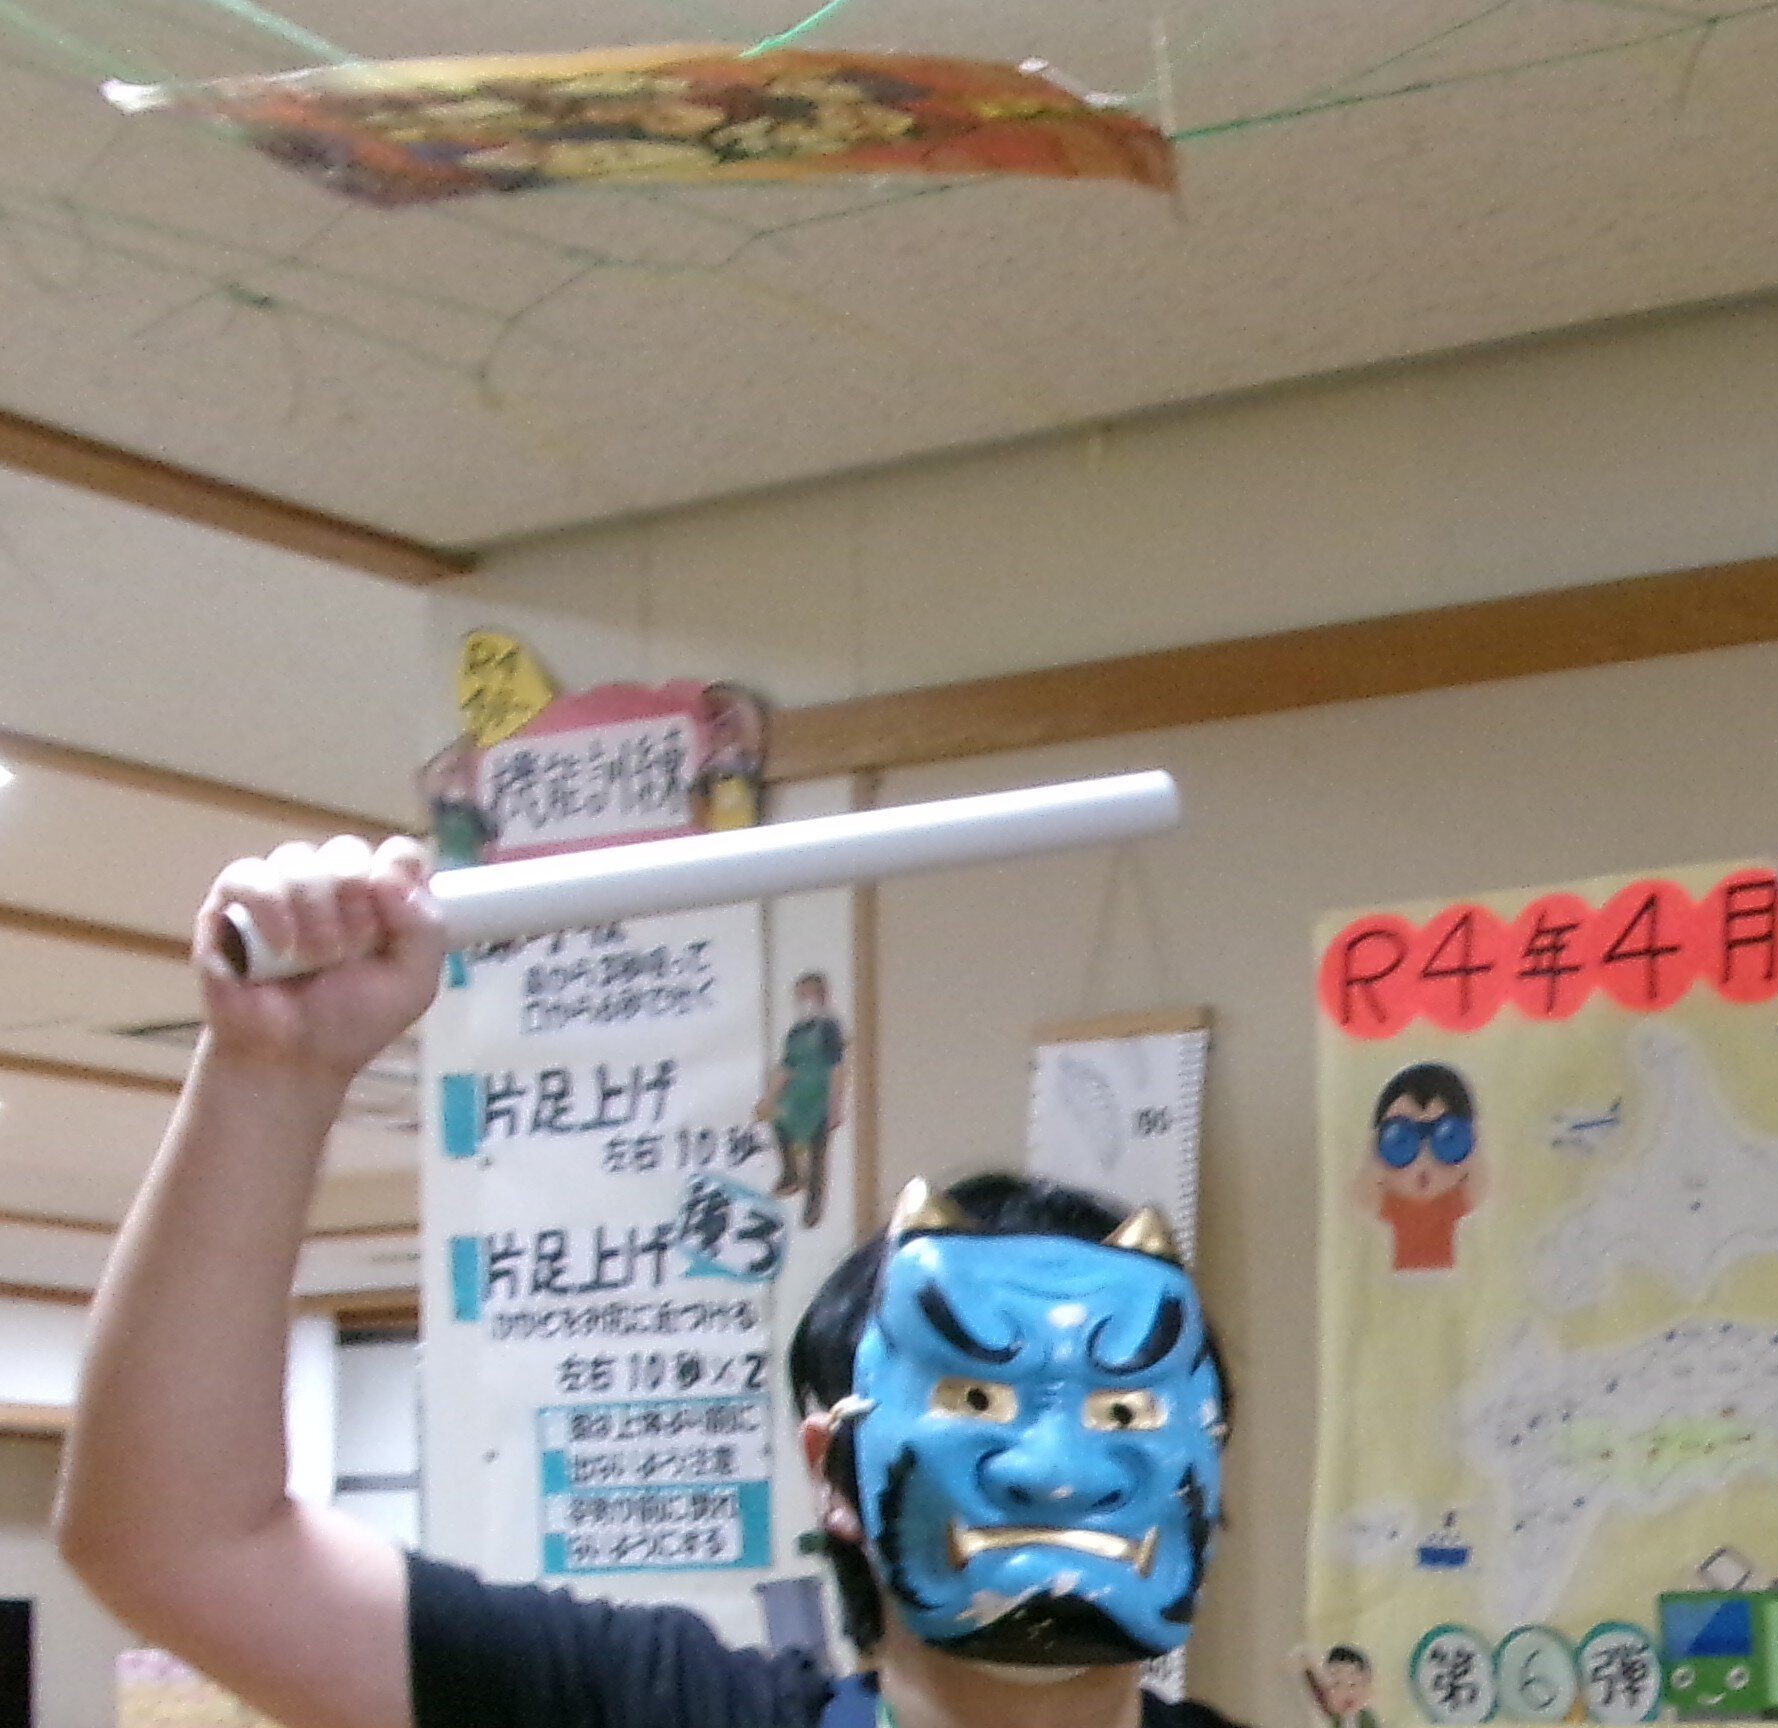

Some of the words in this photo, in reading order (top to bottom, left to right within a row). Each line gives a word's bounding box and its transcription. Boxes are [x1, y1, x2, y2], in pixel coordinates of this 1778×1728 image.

[484, 1059, 677, 1137] 片足上げ
[486, 1226, 674, 1302] 片足上げ
[1428, 1642, 1652, 1712] 第6弾
